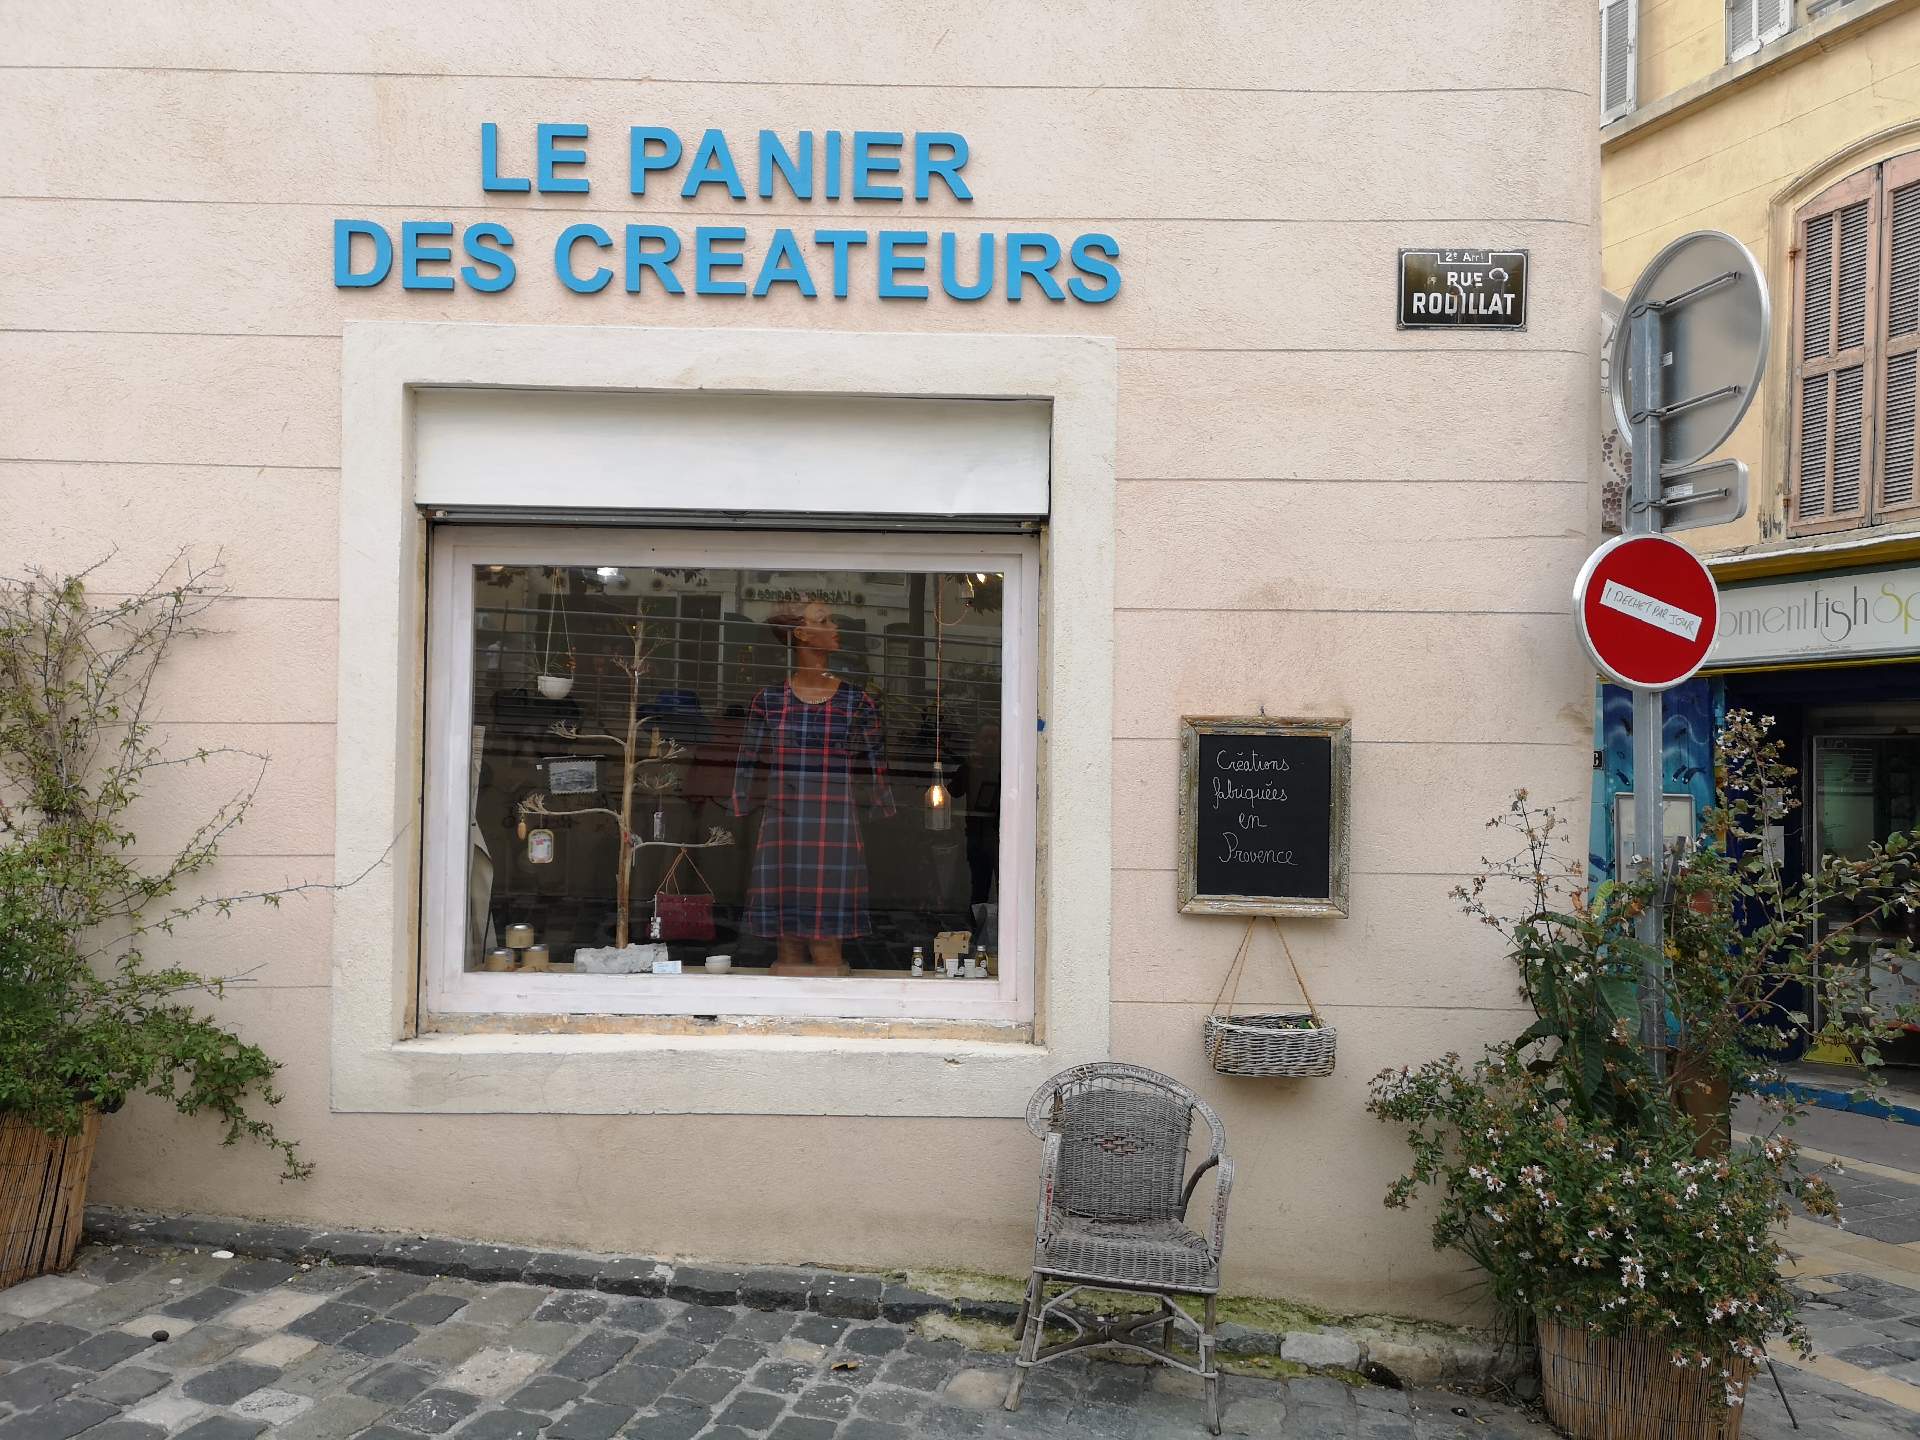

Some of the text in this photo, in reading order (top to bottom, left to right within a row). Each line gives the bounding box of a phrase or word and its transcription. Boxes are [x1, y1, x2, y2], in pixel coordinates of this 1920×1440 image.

[481, 122, 974, 201] LE PANIER
[333, 219, 1122, 304] DES CREATEURS
[1447, 271, 1483, 287] RUE
[1412, 292, 1516, 315] RODILLAT
[1872, 582, 1920, 635] Sp
[1216, 749, 1290, 772] Créations
[1212, 776, 1288, 810] fabriquées
[1238, 812, 1268, 830] en
[1218, 831, 1300, 866] Provence
